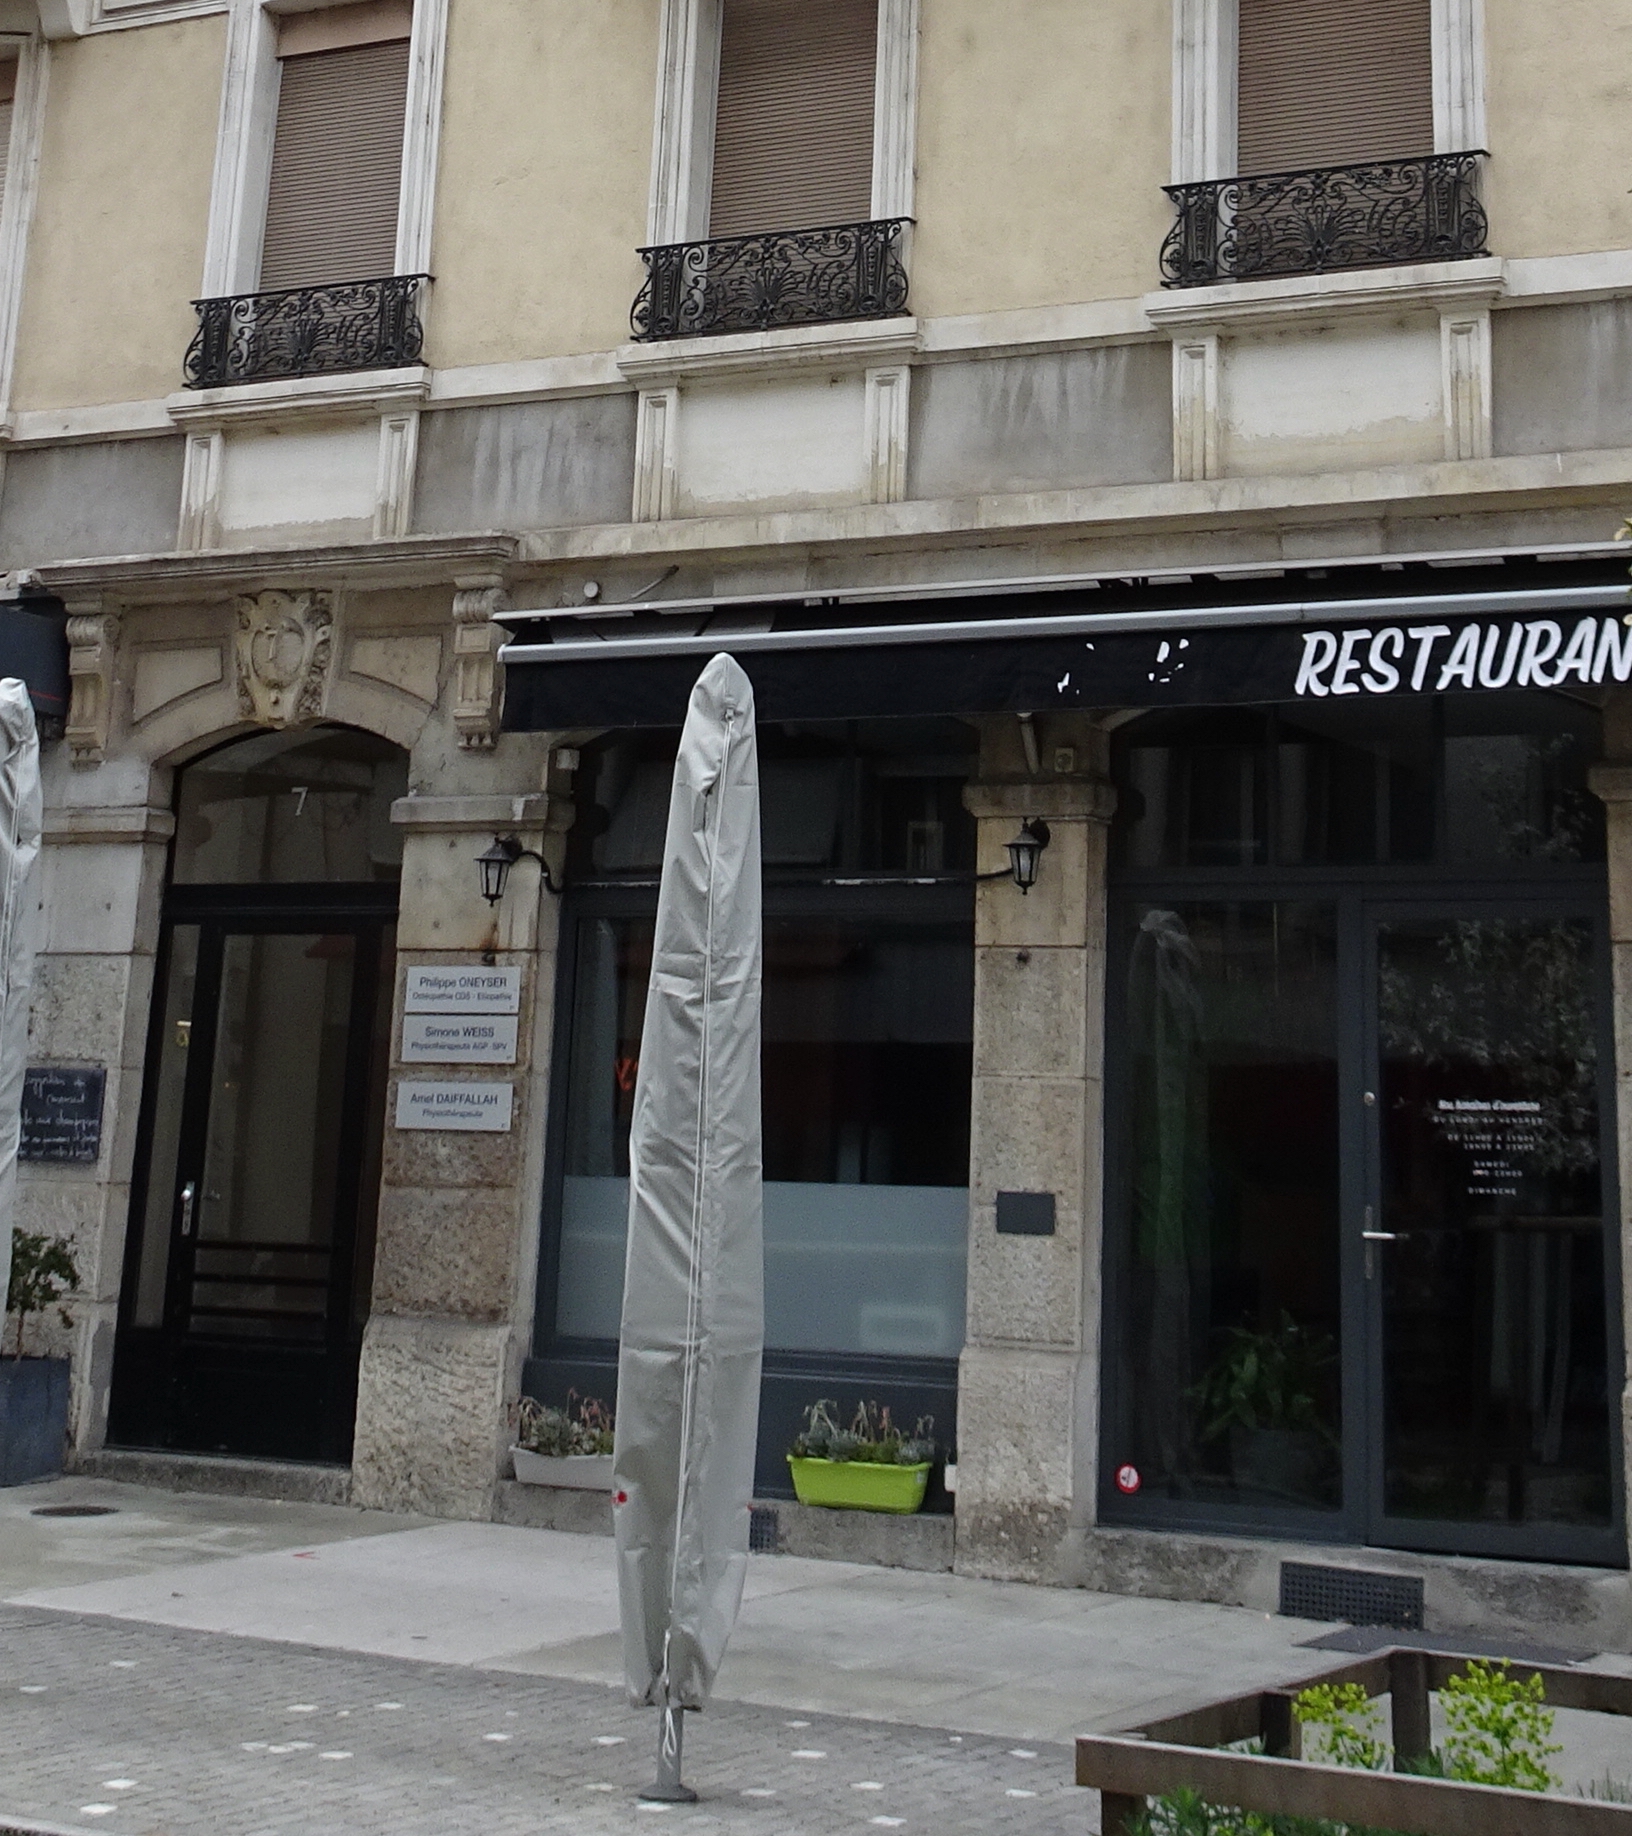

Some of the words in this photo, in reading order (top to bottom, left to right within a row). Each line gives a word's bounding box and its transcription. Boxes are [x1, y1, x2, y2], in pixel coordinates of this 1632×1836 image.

[291, 786, 309, 817] 7
[419, 976, 457, 990] Philippe
[424, 1026, 460, 1038] Simone
[462, 1026, 495, 1038] WEISS
